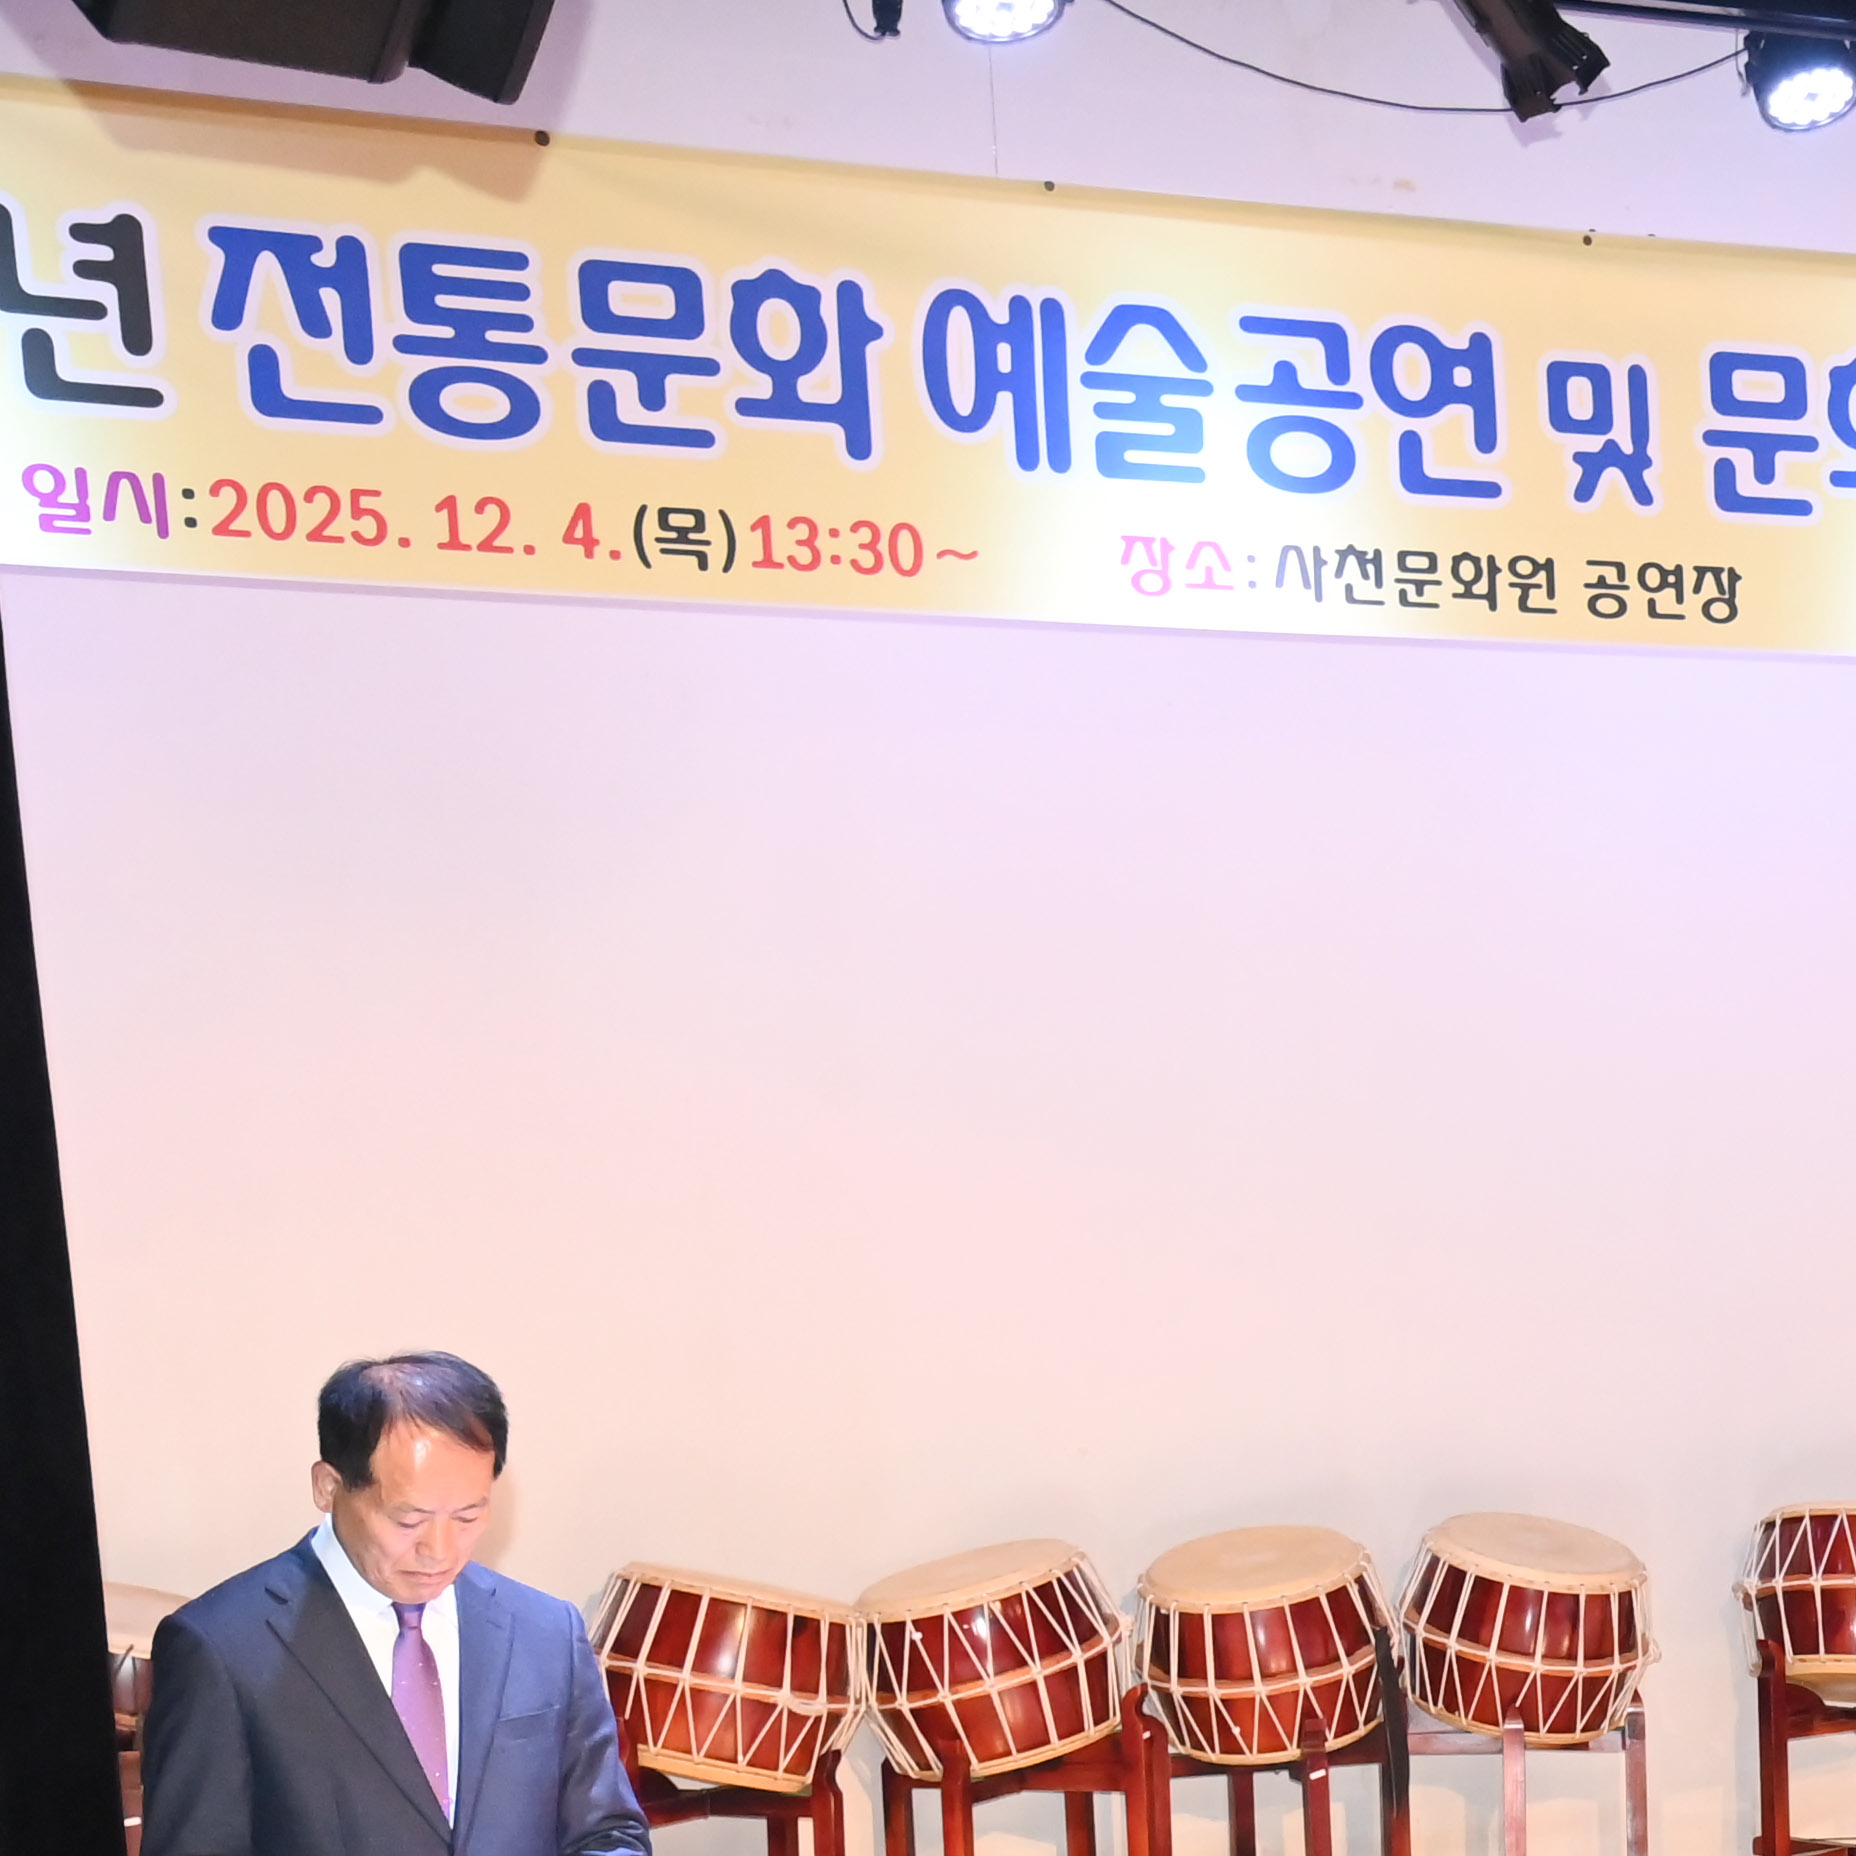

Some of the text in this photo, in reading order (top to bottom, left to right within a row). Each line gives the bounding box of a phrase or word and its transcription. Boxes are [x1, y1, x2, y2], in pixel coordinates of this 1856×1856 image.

[0, 203, 164, 408] 년
[208, 226, 882, 461] 전통문화
[921, 288, 1502, 499] 예술공연
[1547, 358, 1653, 507] 및
[1275, 544, 1558, 615] 사천문화원
[1582, 559, 1743, 625] 공연장
